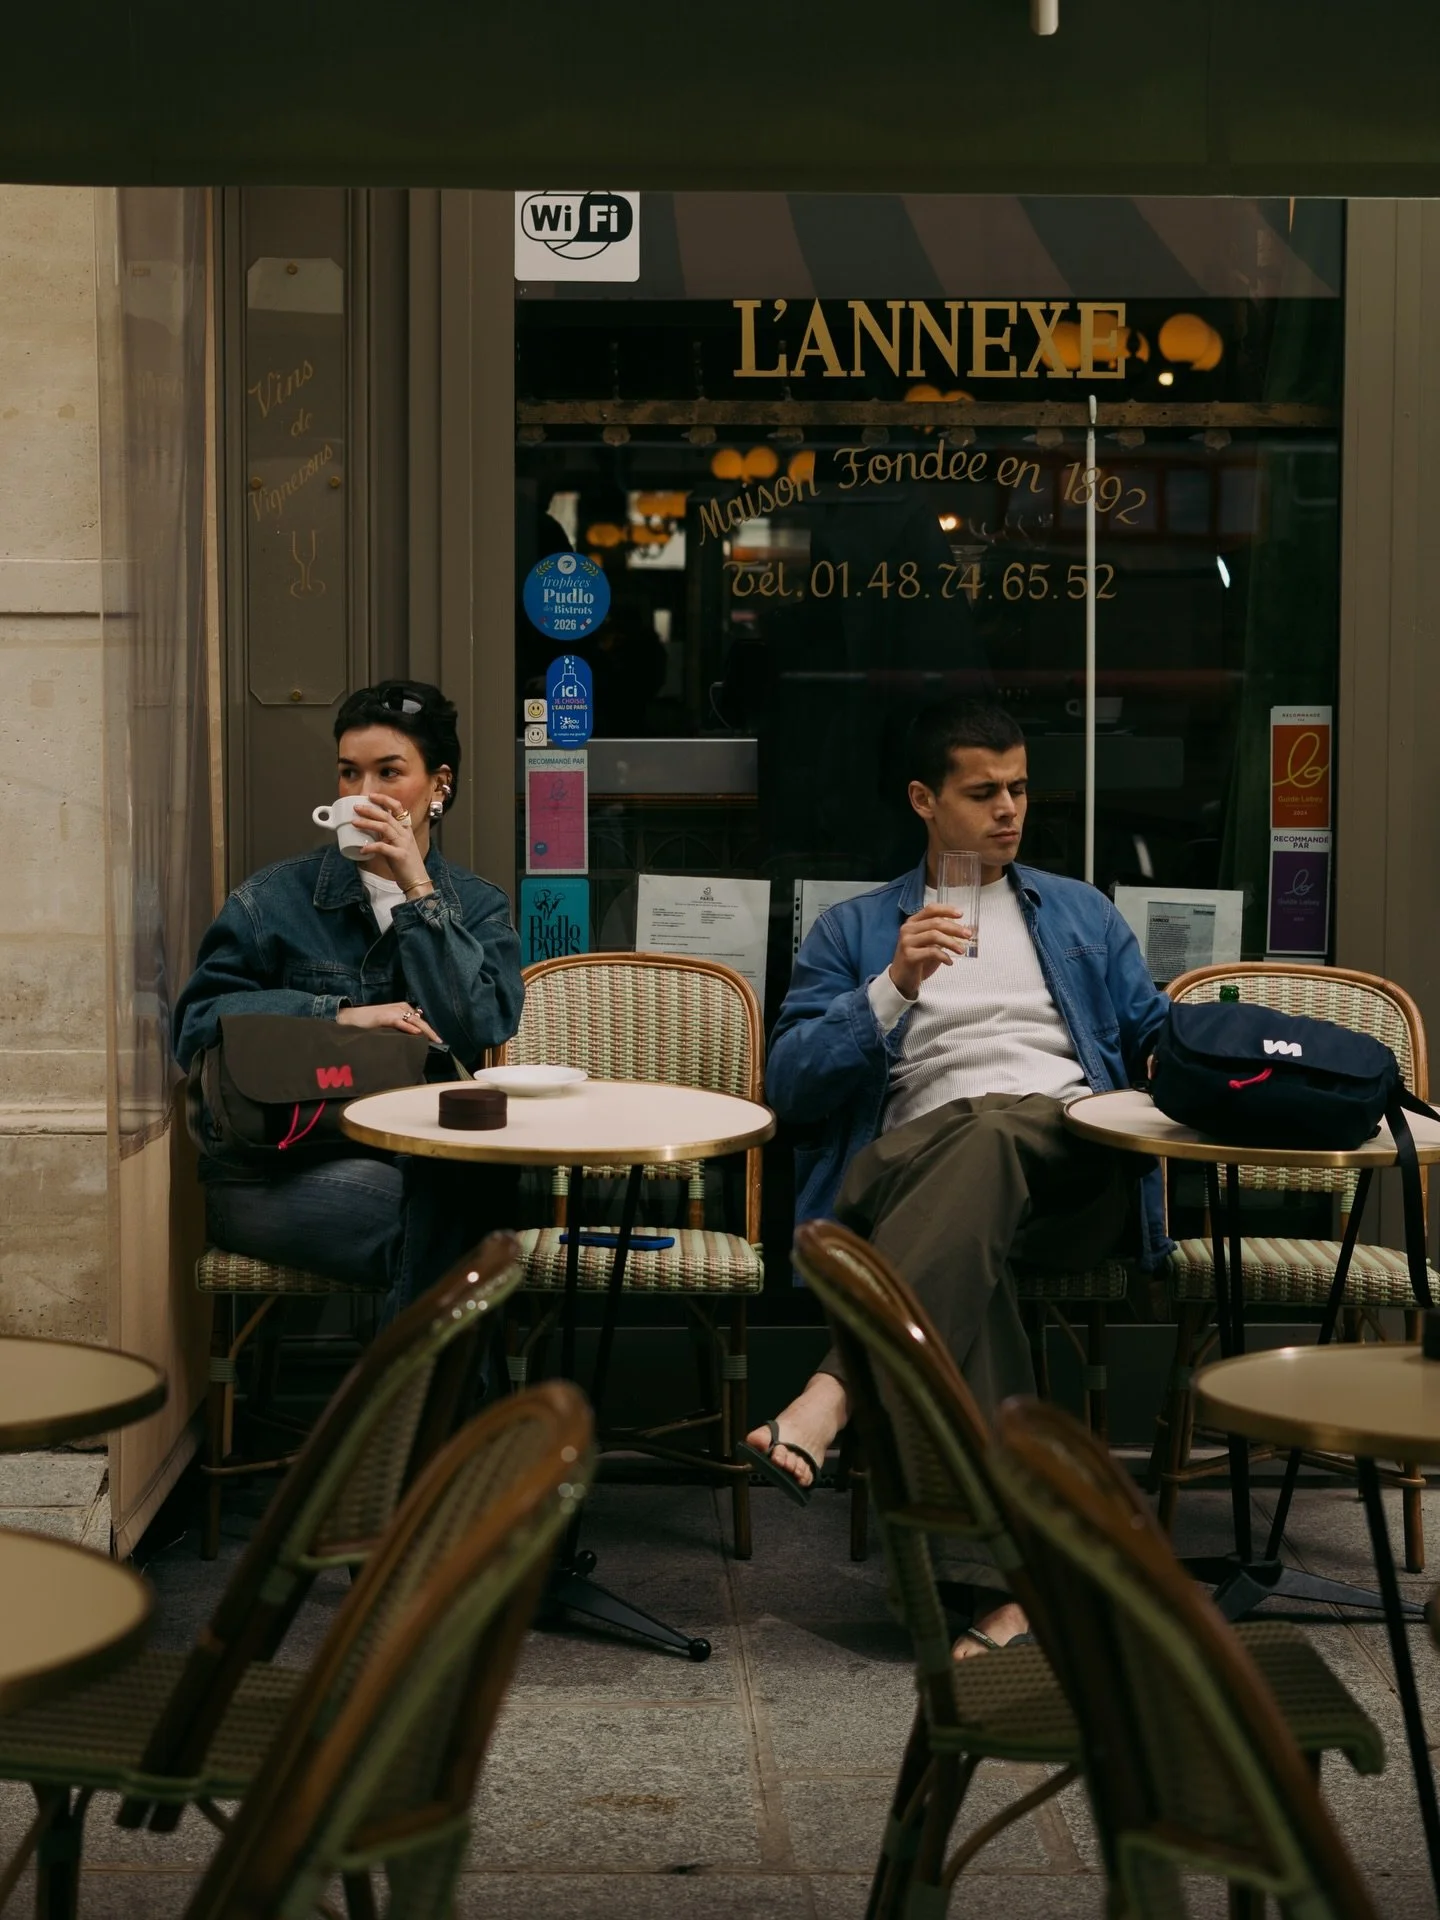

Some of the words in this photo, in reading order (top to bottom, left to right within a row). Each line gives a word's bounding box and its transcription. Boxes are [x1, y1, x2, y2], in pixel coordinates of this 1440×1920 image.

[531, 205, 571, 231] Wi
[590, 205, 618, 232] Fi
[733, 297, 1126, 380] L'ANNEXE
[248, 359, 313, 418] Vins
[291, 408, 313, 436] de
[248, 444, 333, 521] Vignerons
[699, 449, 822, 546] Maison
[833, 439, 987, 489] Fondée
[994, 456, 1044, 493] en
[1063, 462, 1147, 525] 1892
[542, 575, 591, 589] Trophées
[543, 588, 594, 604] Pudlo
[554, 605, 592, 615] Bistrots
[554, 618, 576, 630] 2026
[528, 915, 580, 939] Pudlo
